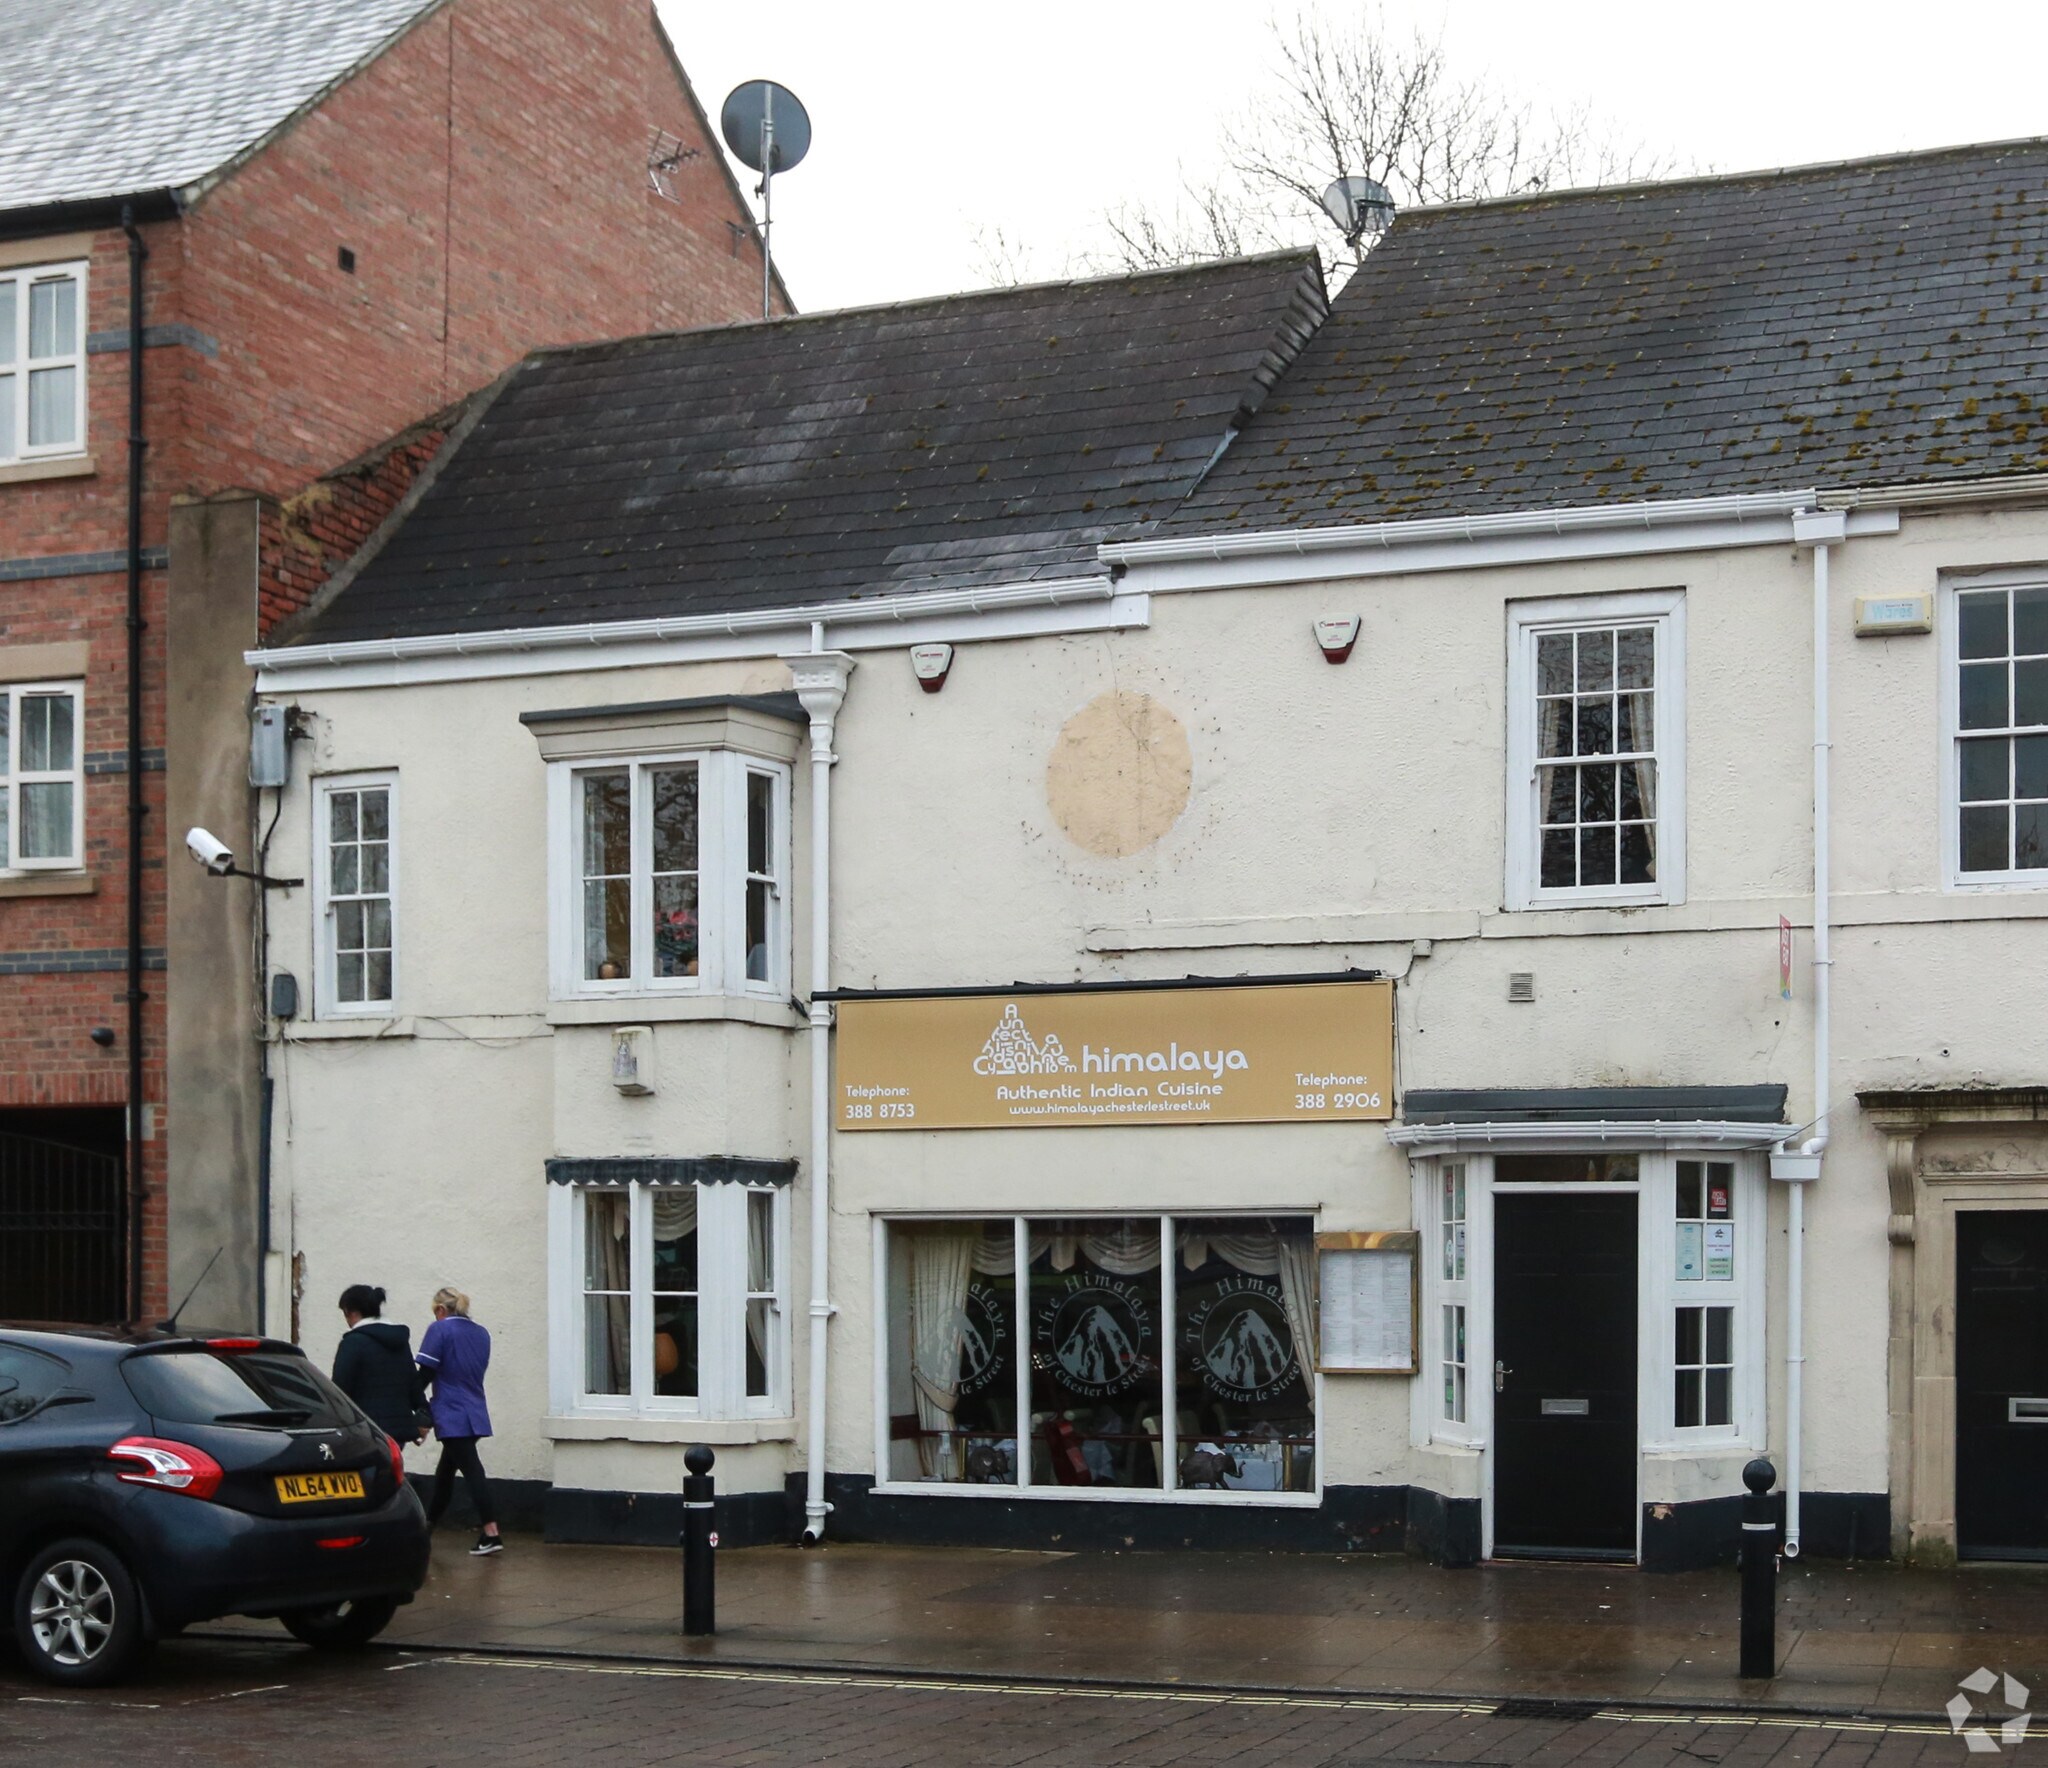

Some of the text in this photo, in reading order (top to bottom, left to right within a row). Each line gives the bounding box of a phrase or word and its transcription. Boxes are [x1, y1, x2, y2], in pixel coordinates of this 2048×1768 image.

[1083, 1042, 1248, 1079] himalaya
[845, 1084, 909, 1101] Telephone:
[997, 1081, 1223, 1100] Authentic Indian Cuisine
[1295, 1073, 1367, 1090] Telephone:
[846, 1103, 915, 1118] 388 8753
[1295, 1092, 1380, 1109] 388 2906
[1038, 1270, 1152, 1340] The Himalaya
[1186, 1299, 1210, 1343] The
[1055, 1369, 1102, 1397] Chester
[1203, 1373, 1251, 1402] Chester
[283, 1476, 327, 1498] NL64
